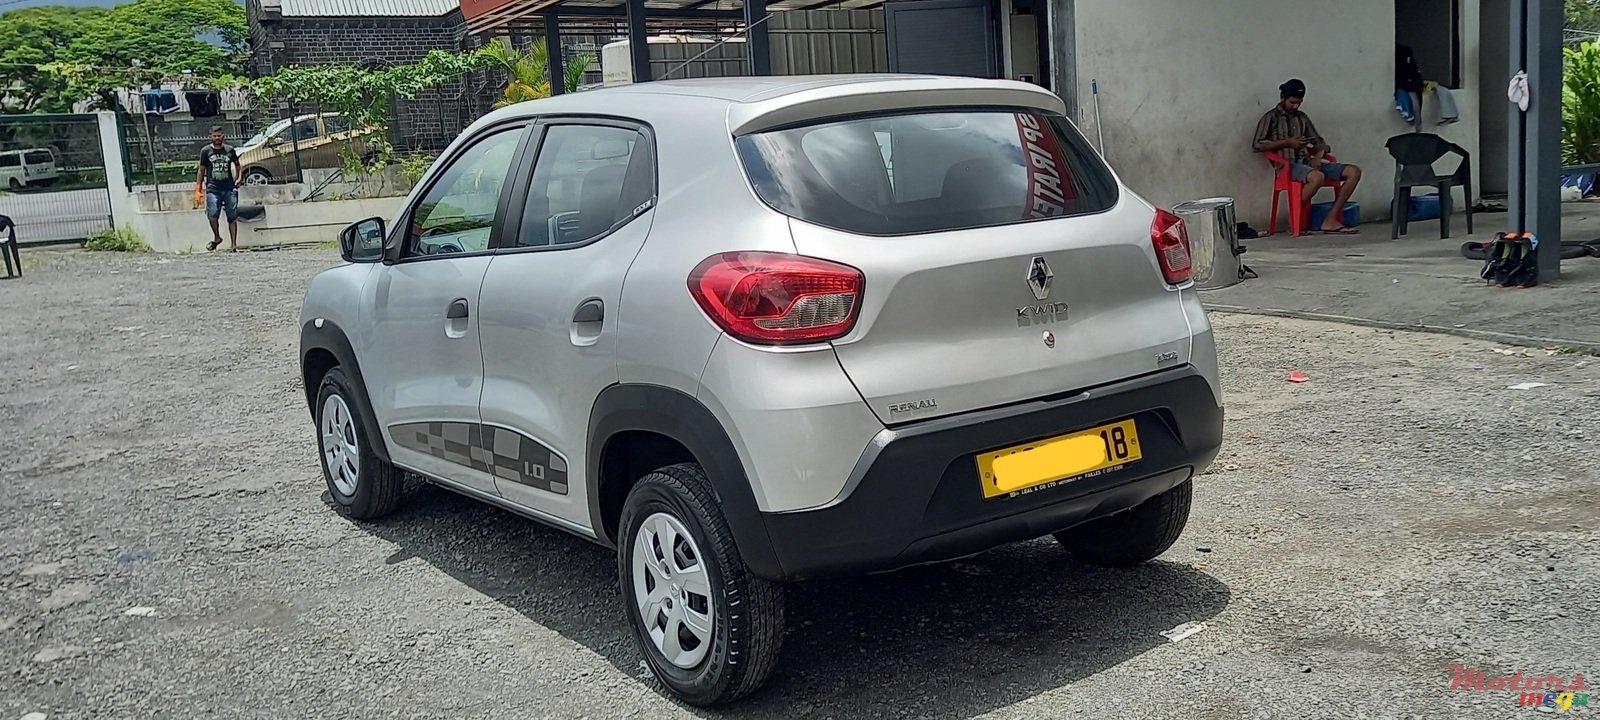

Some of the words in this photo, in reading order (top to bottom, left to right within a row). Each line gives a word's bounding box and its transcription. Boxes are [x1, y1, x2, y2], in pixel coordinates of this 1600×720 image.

[1016, 302, 1068, 318] KWID
[1100, 426, 1129, 462] 18
[524, 461, 545, 480] 1.0
